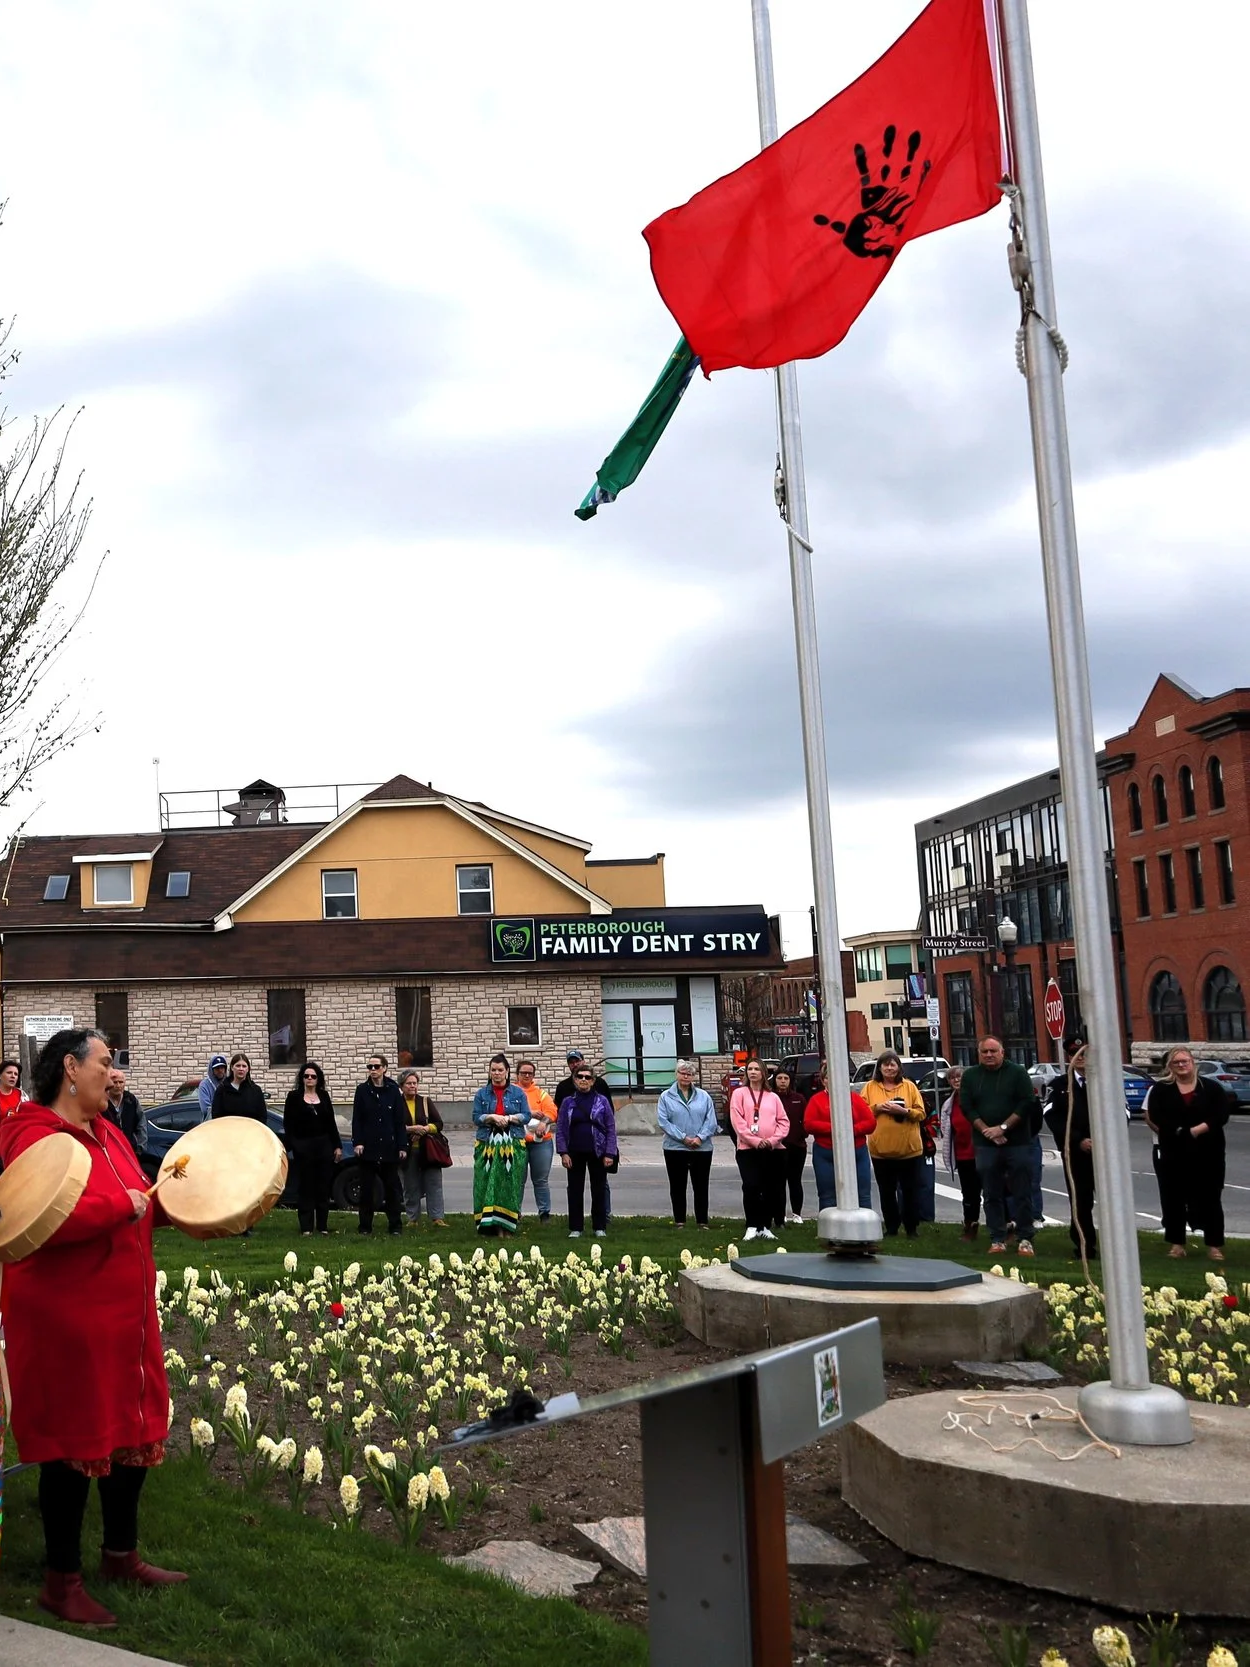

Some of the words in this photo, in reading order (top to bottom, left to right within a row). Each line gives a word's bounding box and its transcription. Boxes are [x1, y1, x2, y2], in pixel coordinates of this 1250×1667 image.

[540, 921, 665, 935] PETERBOROUGH
[541, 936, 623, 955] FAMILY
[925, 939, 957, 949] Murray
[960, 939, 985, 947] Street
[616, 980, 673, 989] PETERBOROUGH
[1046, 1000, 1062, 1022] STOP
